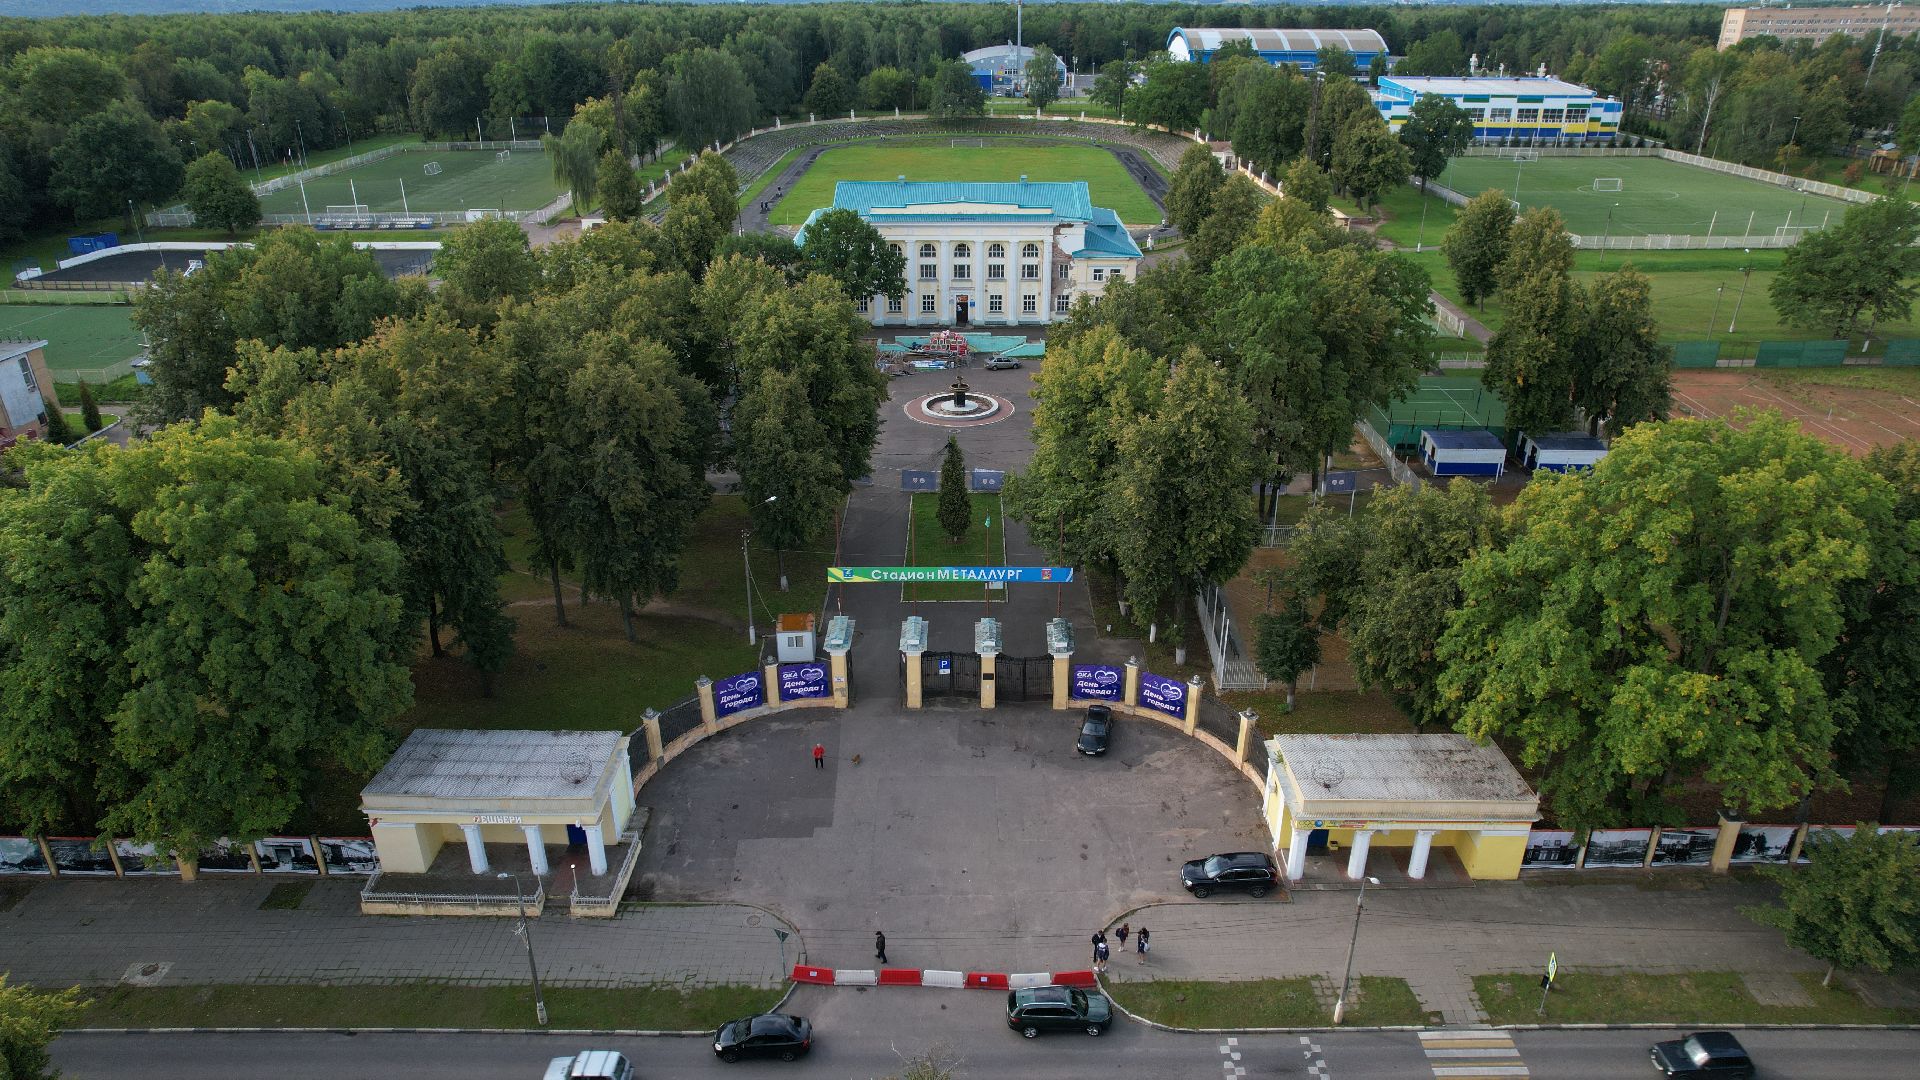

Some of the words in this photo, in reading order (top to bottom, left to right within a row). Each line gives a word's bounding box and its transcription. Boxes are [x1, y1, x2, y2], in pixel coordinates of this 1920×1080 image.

[871, 569, 935, 581] Стадион
[937, 569, 1023, 580] МЕТАЛЛУРГ
[941, 660, 948, 668] P
[784, 680, 806, 689] День
[1076, 680, 1099, 688] День
[720, 693, 741, 704] День
[1143, 689, 1164, 701] День
